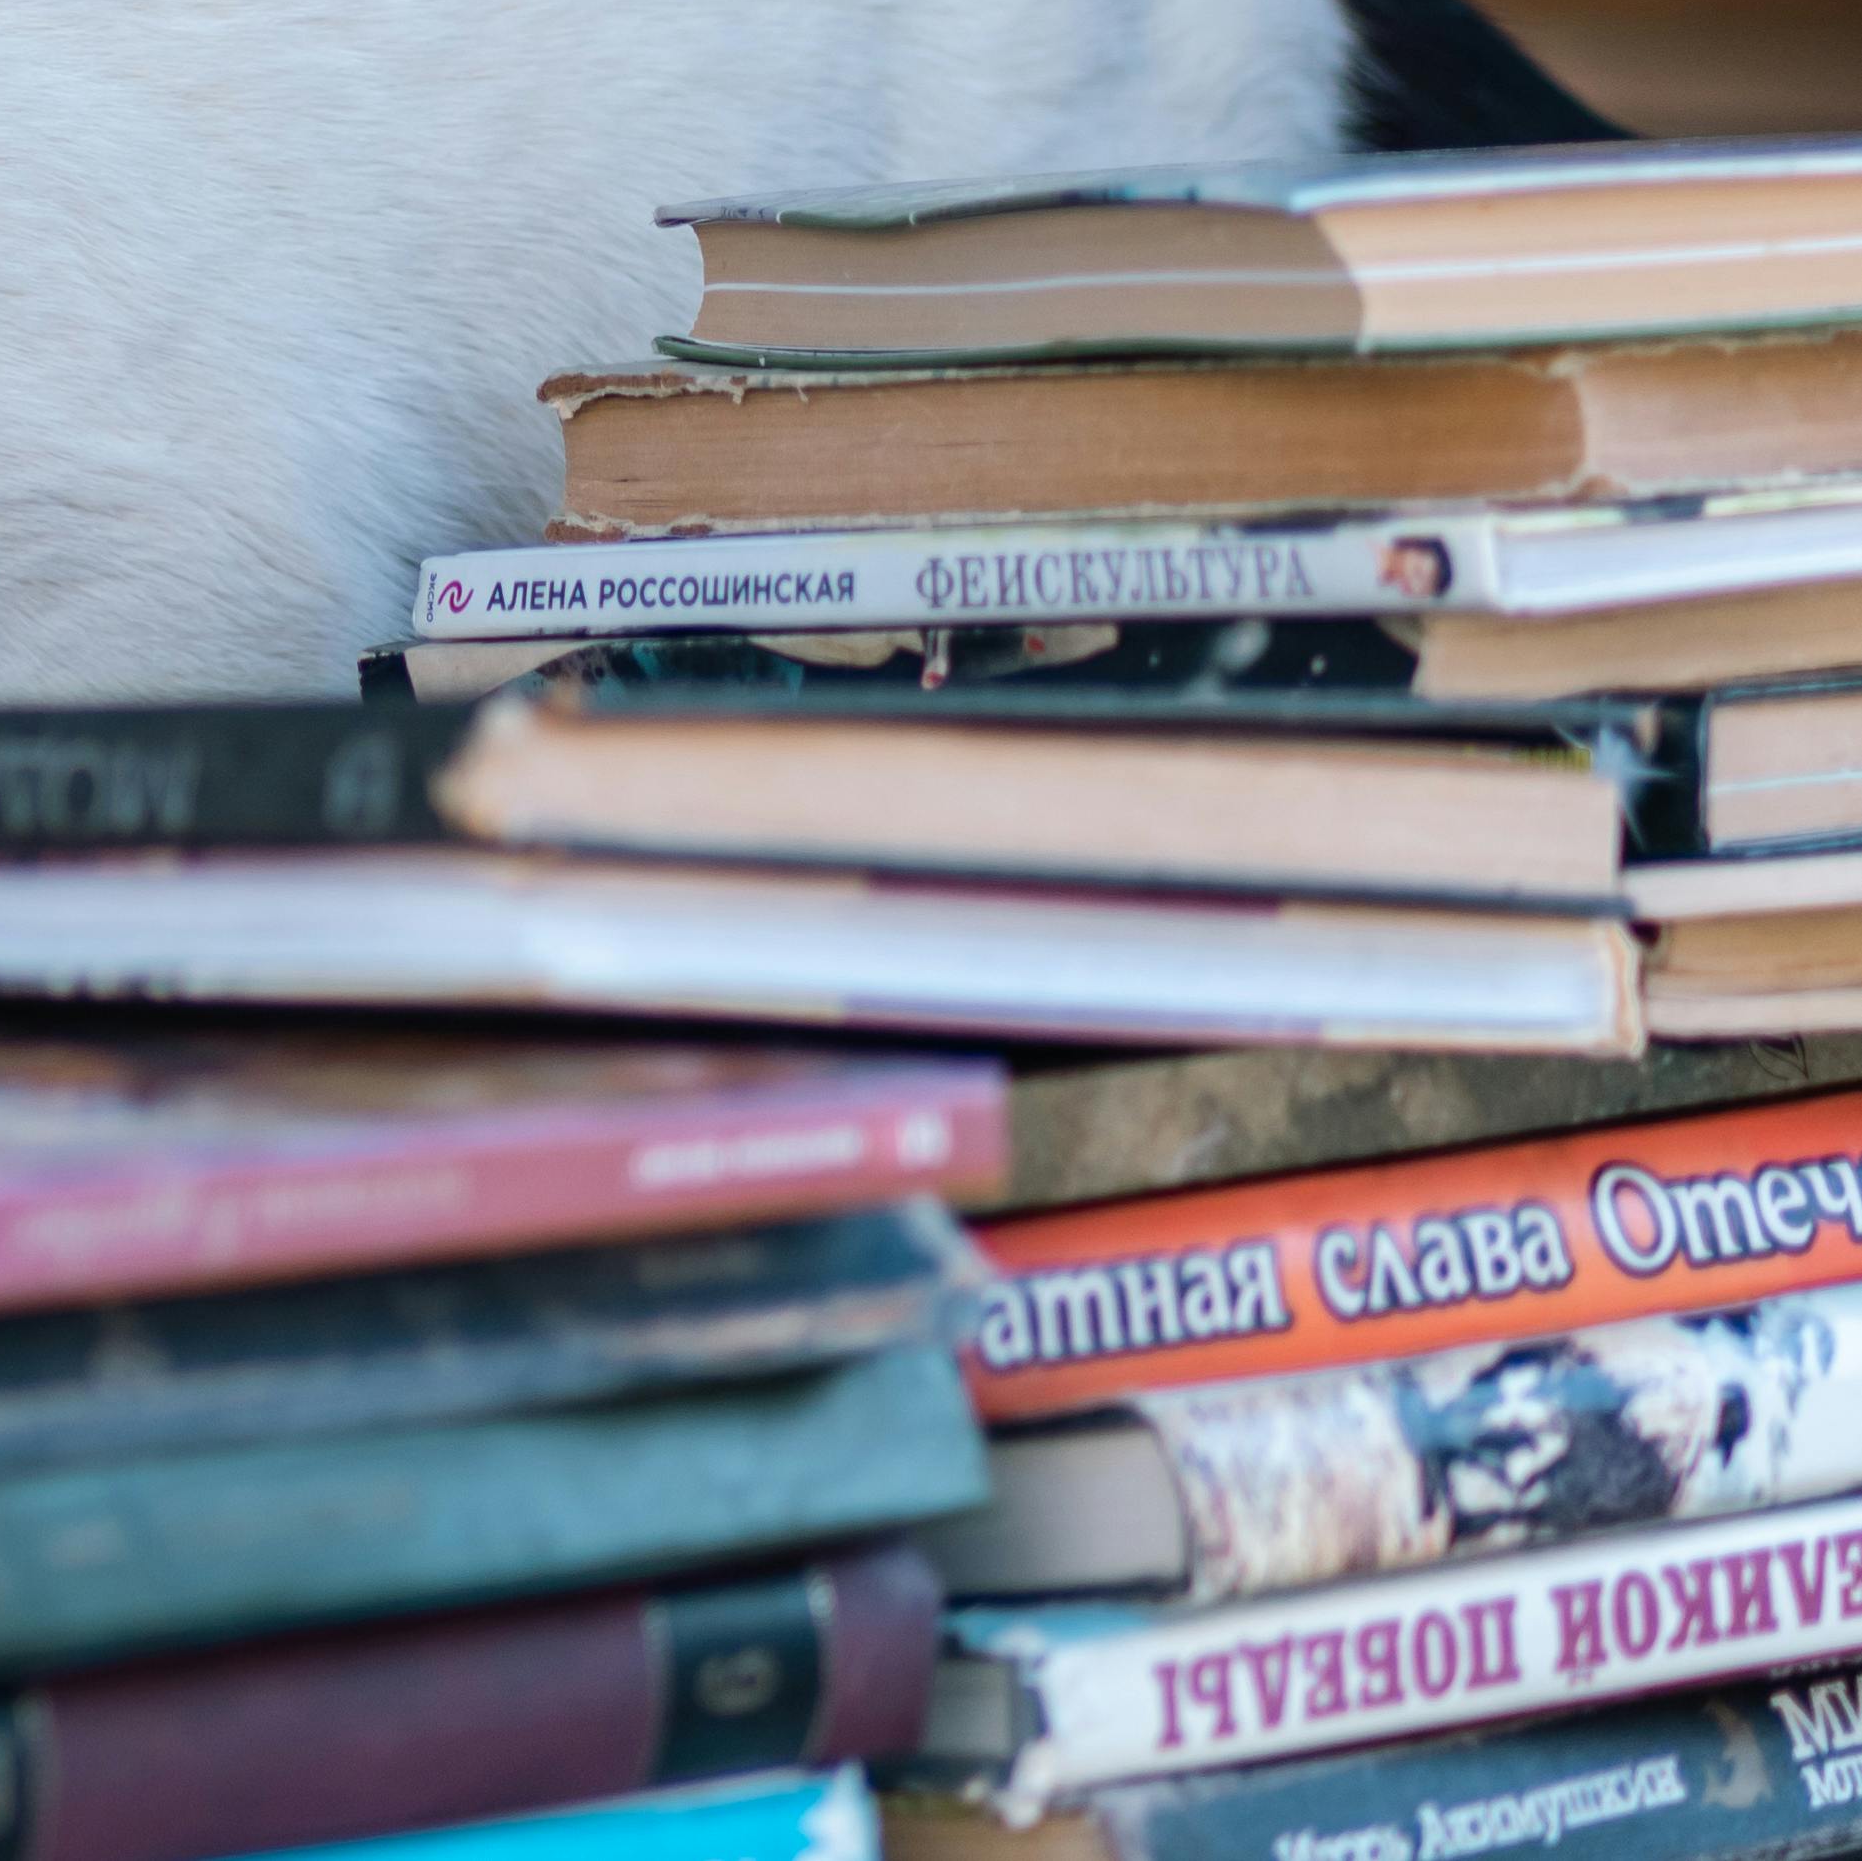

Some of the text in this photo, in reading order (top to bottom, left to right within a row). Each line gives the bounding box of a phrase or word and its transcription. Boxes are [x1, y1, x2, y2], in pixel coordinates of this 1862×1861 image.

[426, 572, 438, 623] ЭКСМО
[486, 572, 856, 612] АЛЕНА РОССОШИНСКАЯ
[977, 1242, 1289, 1370] атная
[1316, 1198, 1572, 1318] слава
[1153, 1600, 1518, 1749] ПОБЕДЫ
